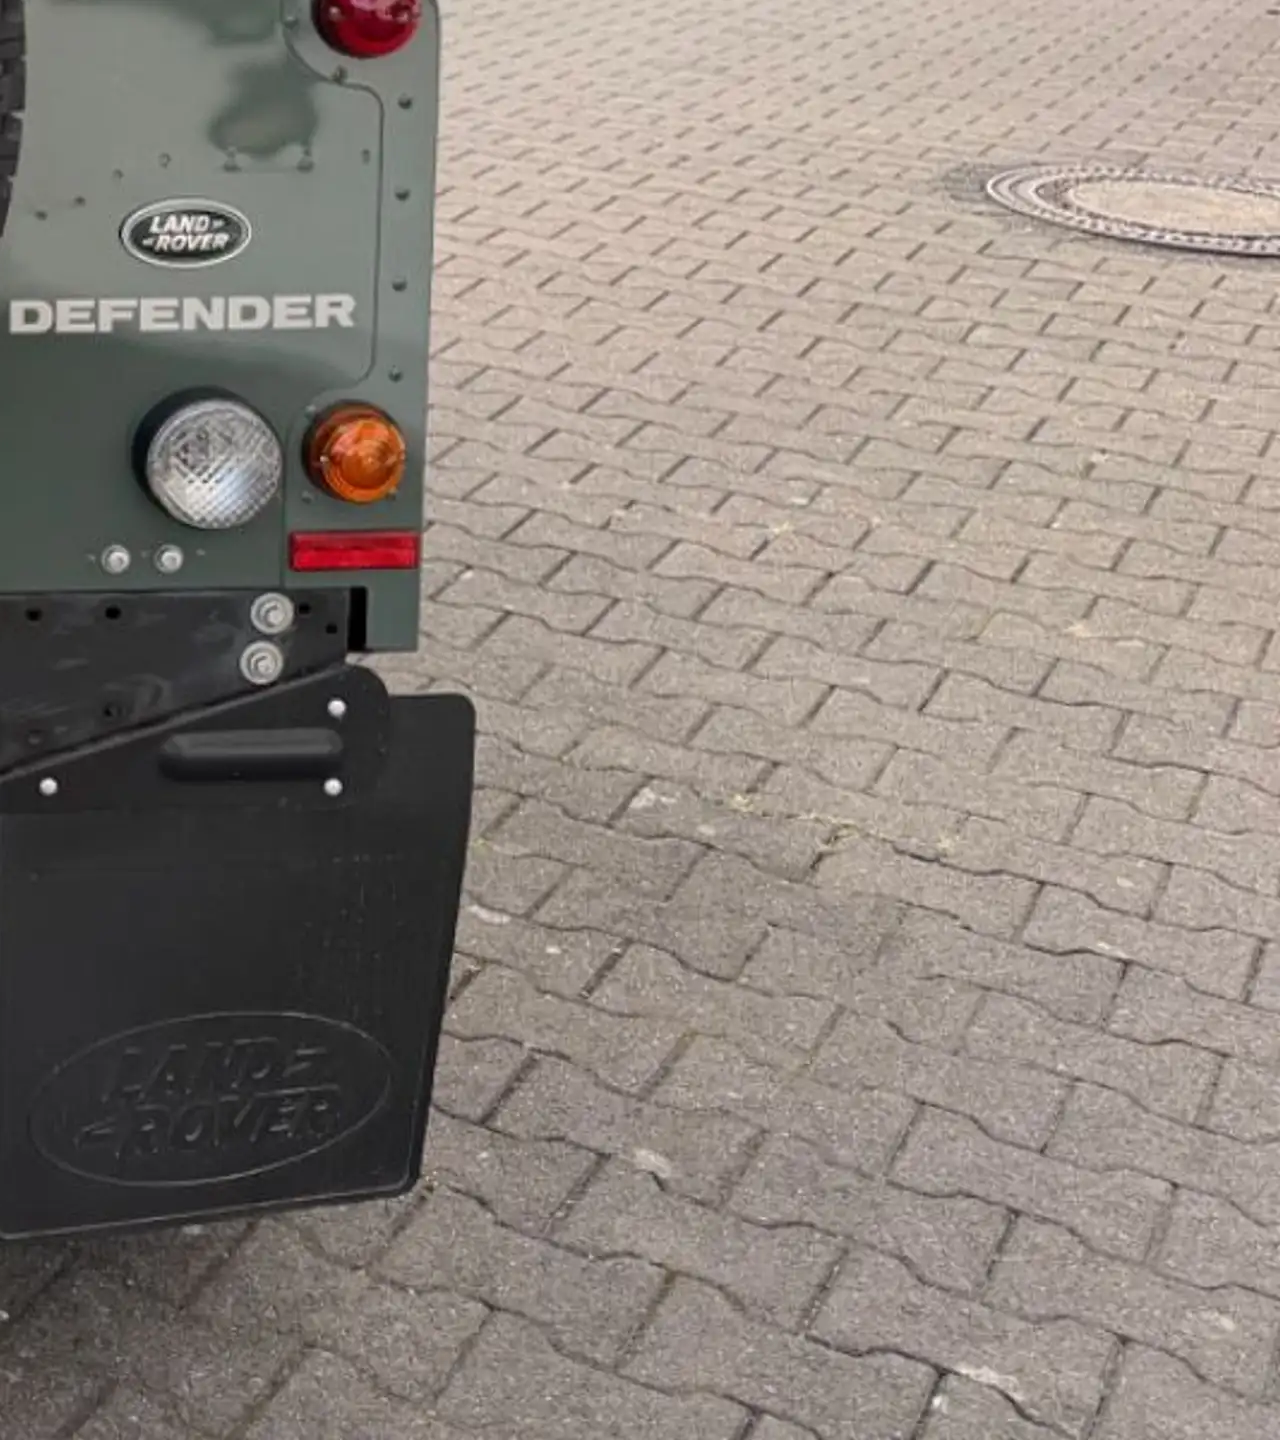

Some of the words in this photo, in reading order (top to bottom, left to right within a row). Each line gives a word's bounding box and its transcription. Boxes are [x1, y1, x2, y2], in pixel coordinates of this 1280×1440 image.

[149, 214, 210, 233] LAND
[153, 232, 231, 252] ROVER
[8, 292, 356, 335] DEFENDER
[100, 1036, 281, 1105] LAND
[112, 1082, 340, 1162] ROVER
